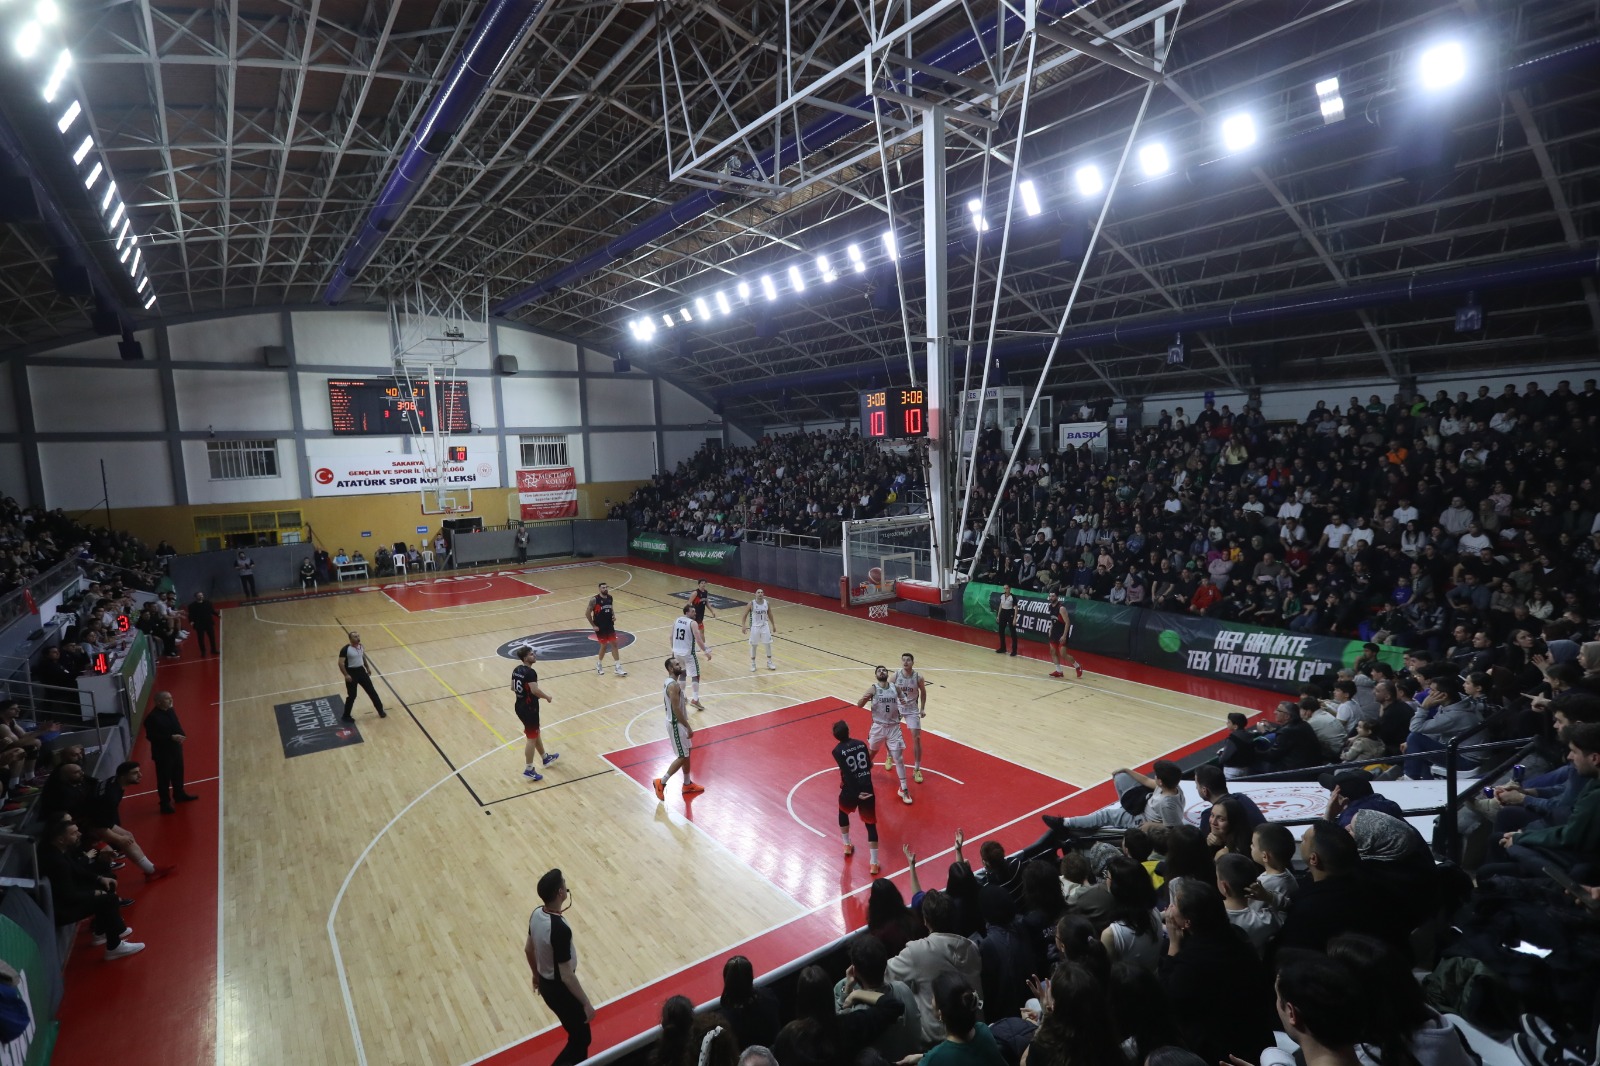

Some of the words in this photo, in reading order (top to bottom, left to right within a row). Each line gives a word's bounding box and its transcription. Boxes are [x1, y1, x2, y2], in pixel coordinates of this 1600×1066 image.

[385, 387, 398, 396] 40
[901, 390, 923, 405] 3:08
[397, 401, 416, 411] 3:08
[866, 392, 886, 408] 3:08
[384, 410, 390, 418] 3
[401, 410, 407, 418] 2
[905, 408, 921, 434] 10
[870, 411, 885, 436] 10
[1067, 431, 1102, 439] BASIN
[457, 451, 465, 461] 10
[349, 468, 380, 476] GENÇLİK
[336, 477, 386, 488] ATATÜRK
[390, 477, 417, 486] SPOR
[358, 570, 517, 592] SAKARYA
[117, 615, 130, 632] 3
[1021, 615, 1035, 630] DE
[675, 627, 686, 640] 13
[1213, 630, 1246, 651] HEP
[1243, 631, 1313, 657] BİRLİKTE
[94, 653, 108, 674] 4
[1186, 650, 1213, 671] TEK
[1214, 650, 1262, 680] YÜREK,
[1267, 657, 1298, 681] TEK
[513, 678, 524, 694] 16
[885, 704, 890, 713] 6
[845, 751, 868, 772] 98
